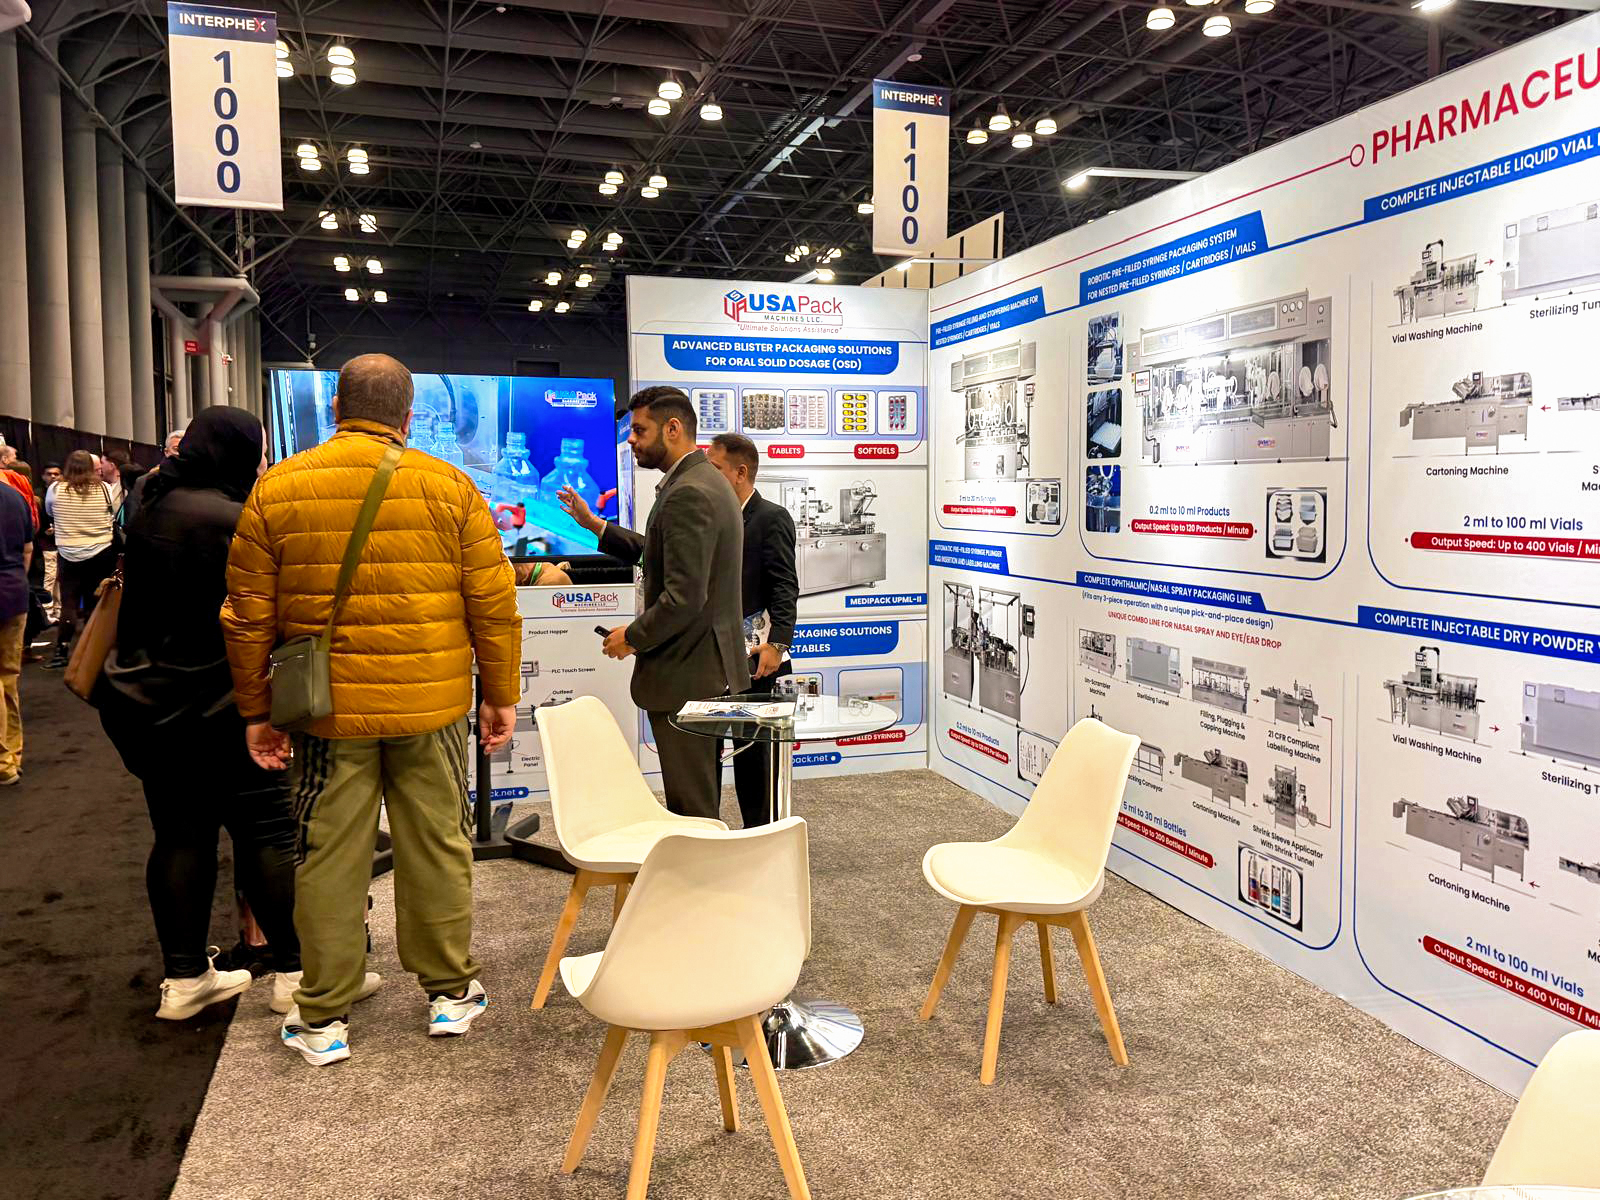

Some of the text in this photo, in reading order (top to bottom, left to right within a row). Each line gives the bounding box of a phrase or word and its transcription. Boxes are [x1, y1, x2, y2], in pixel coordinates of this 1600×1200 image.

[179, 12, 267, 33] INTERPHEX
[880, 89, 943, 106] INTERPHEX
[1372, 47, 1600, 165] PHARMACEU
[213, 50, 241, 194] 1000
[902, 121, 919, 245] 1100
[1381, 138, 1594, 211] COMPLETE INJECTABLE LIQUID VIAL
[1088, 228, 1237, 286] ROBOTIC PRE-FILLED SYRINGE PACKAGING SYSTEM
[1088, 241, 1256, 300] FOR NESTED PRE-FILLED SYRINGES CARTRIDGES VIALS
[1529, 303, 1579, 319] Sterilizing
[770, 324, 800, 333] Solutions
[1392, 322, 1483, 344] Vial Washing Machine
[672, 340, 892, 355] ADVANCED BLISTER PACKAGING SOLUTIONS
[706, 357, 862, 370] FOR ORAL SOLID DOSAGE (OSD)
[771, 447, 801, 455] TABLETS
[857, 447, 896, 455] SOFTGELS
[1426, 466, 1509, 478] Cartoning Machine
[1149, 505, 1230, 517] 0.2 ml to 10 ml Products
[1134, 522, 1249, 535] Output Speed: Up to 120 Products Minute
[1463, 516, 1583, 531] 2 ml to 100 ml Vials
[1431, 537, 1575, 554] Output Speed: Up to 400 Vials
[850, 597, 891, 605] MEDIPACK
[1084, 575, 1252, 605] COMPLETE OPHTHALMIC/NASAL SPRAY PACKAGING LINE
[1103, 594, 1123, 605] 3-piece
[1124, 599, 1150, 609] operation
[1150, 602, 1163, 611] with
[1169, 606, 1190, 617] unique
[1191, 608, 1244, 625] pick-and-place
[1245, 615, 1274, 630] design)
[792, 626, 892, 638] CKAGING SOLUTIONS
[1108, 610, 1282, 649] UNIQUE COMBO LINE FOR NASAL SPRAY AND EYE/EAR DROP
[1374, 612, 1594, 654] COMPLETE INJECTABLE DRY POWDER
[789, 643, 831, 654] CTABLES
[1200, 720, 1245, 740] Capping Machine
[1216, 712, 1240, 729] Plugging
[873, 732, 903, 740] SYRINGES
[1267, 729, 1320, 752] 21 CFR Compliant
[1266, 741, 1321, 763] Labelling Machine
[1392, 733, 1482, 764] Vial Washing Machine
[1541, 771, 1591, 795] Sterilizing
[1137, 807, 1144, 817] to
[1163, 820, 1187, 837] Bottles
[1252, 824, 1323, 859] Shrink Sleeve Applicator
[1260, 839, 1315, 867] With Shrink Tunnel
[1428, 873, 1511, 912] Cartoning Machine
[1466, 936, 1584, 998] 2 ml to 100 ml Vials
[1433, 943, 1575, 1016] Output Speed: Up to 400 Vials
